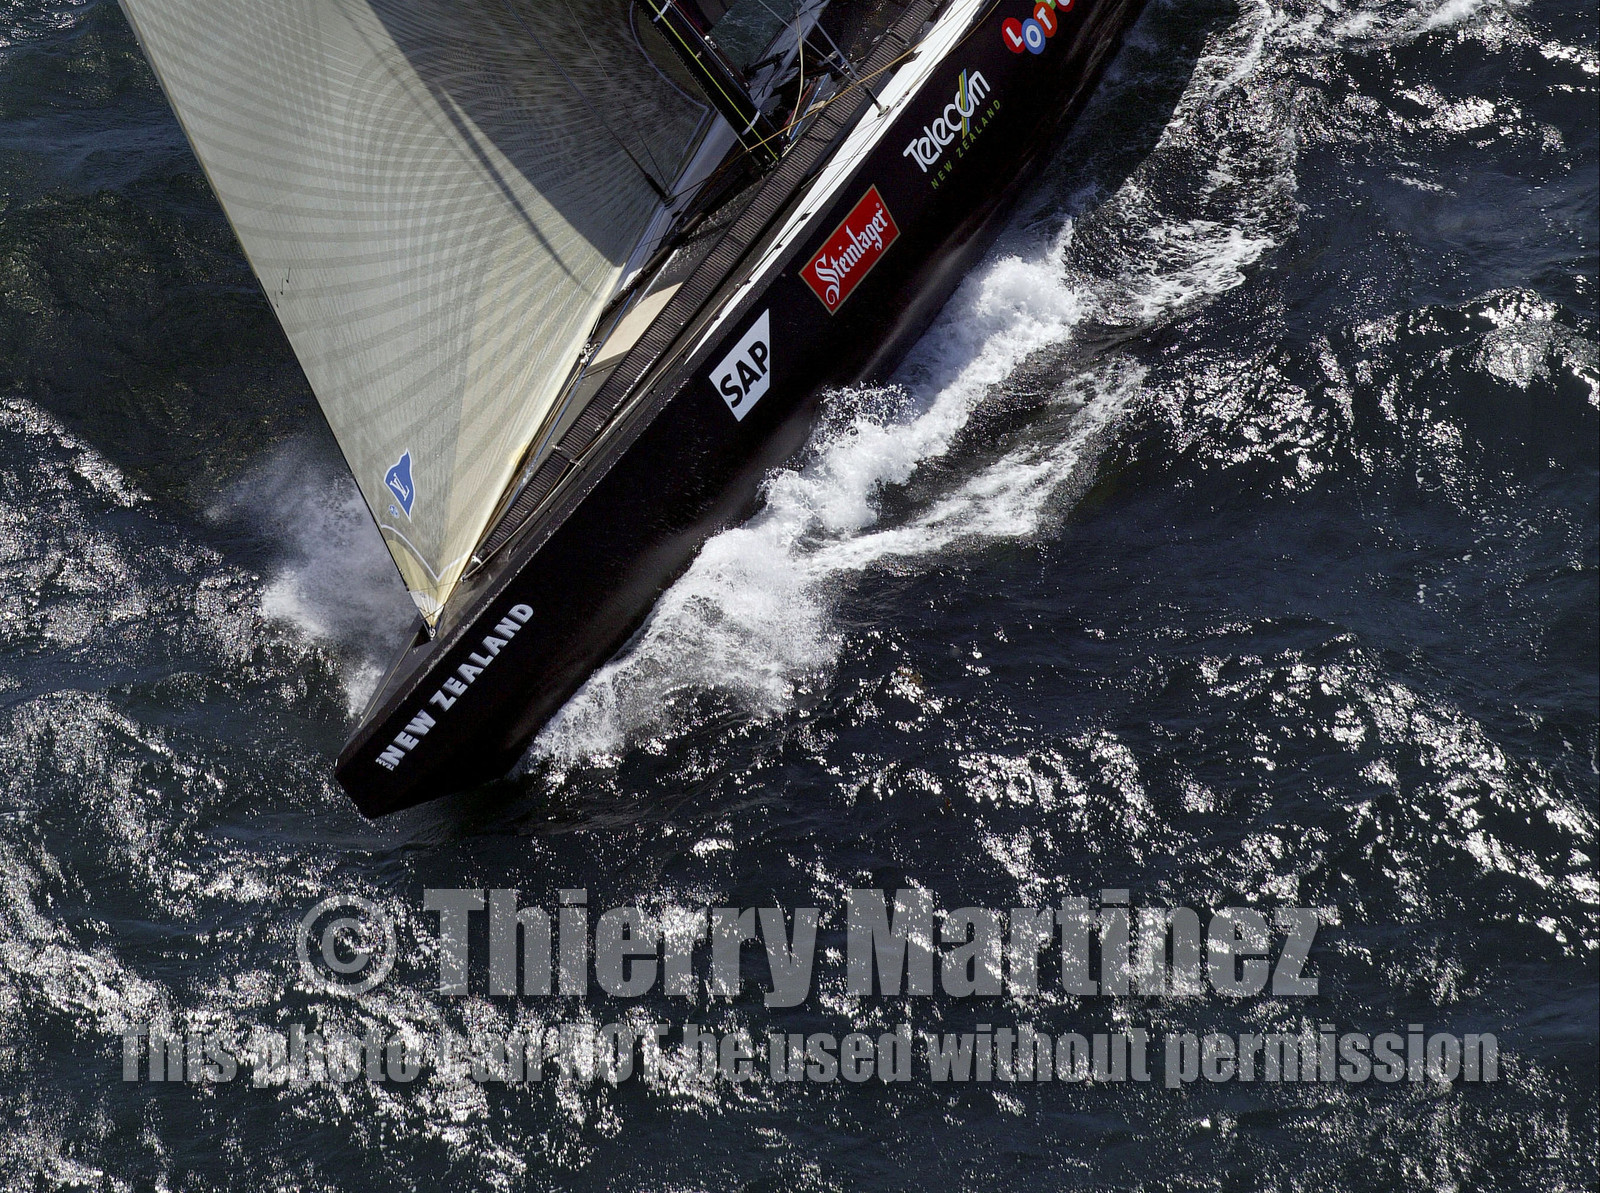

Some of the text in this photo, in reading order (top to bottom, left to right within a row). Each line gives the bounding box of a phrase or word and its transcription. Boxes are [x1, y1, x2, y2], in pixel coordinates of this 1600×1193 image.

[902, 70, 991, 173] Telecom
[930, 99, 1001, 190] NEW ZEALAND
[814, 208, 889, 305] Steinlager
[720, 340, 768, 409] SAP
[379, 603, 534, 767] NEW ZEALAND
